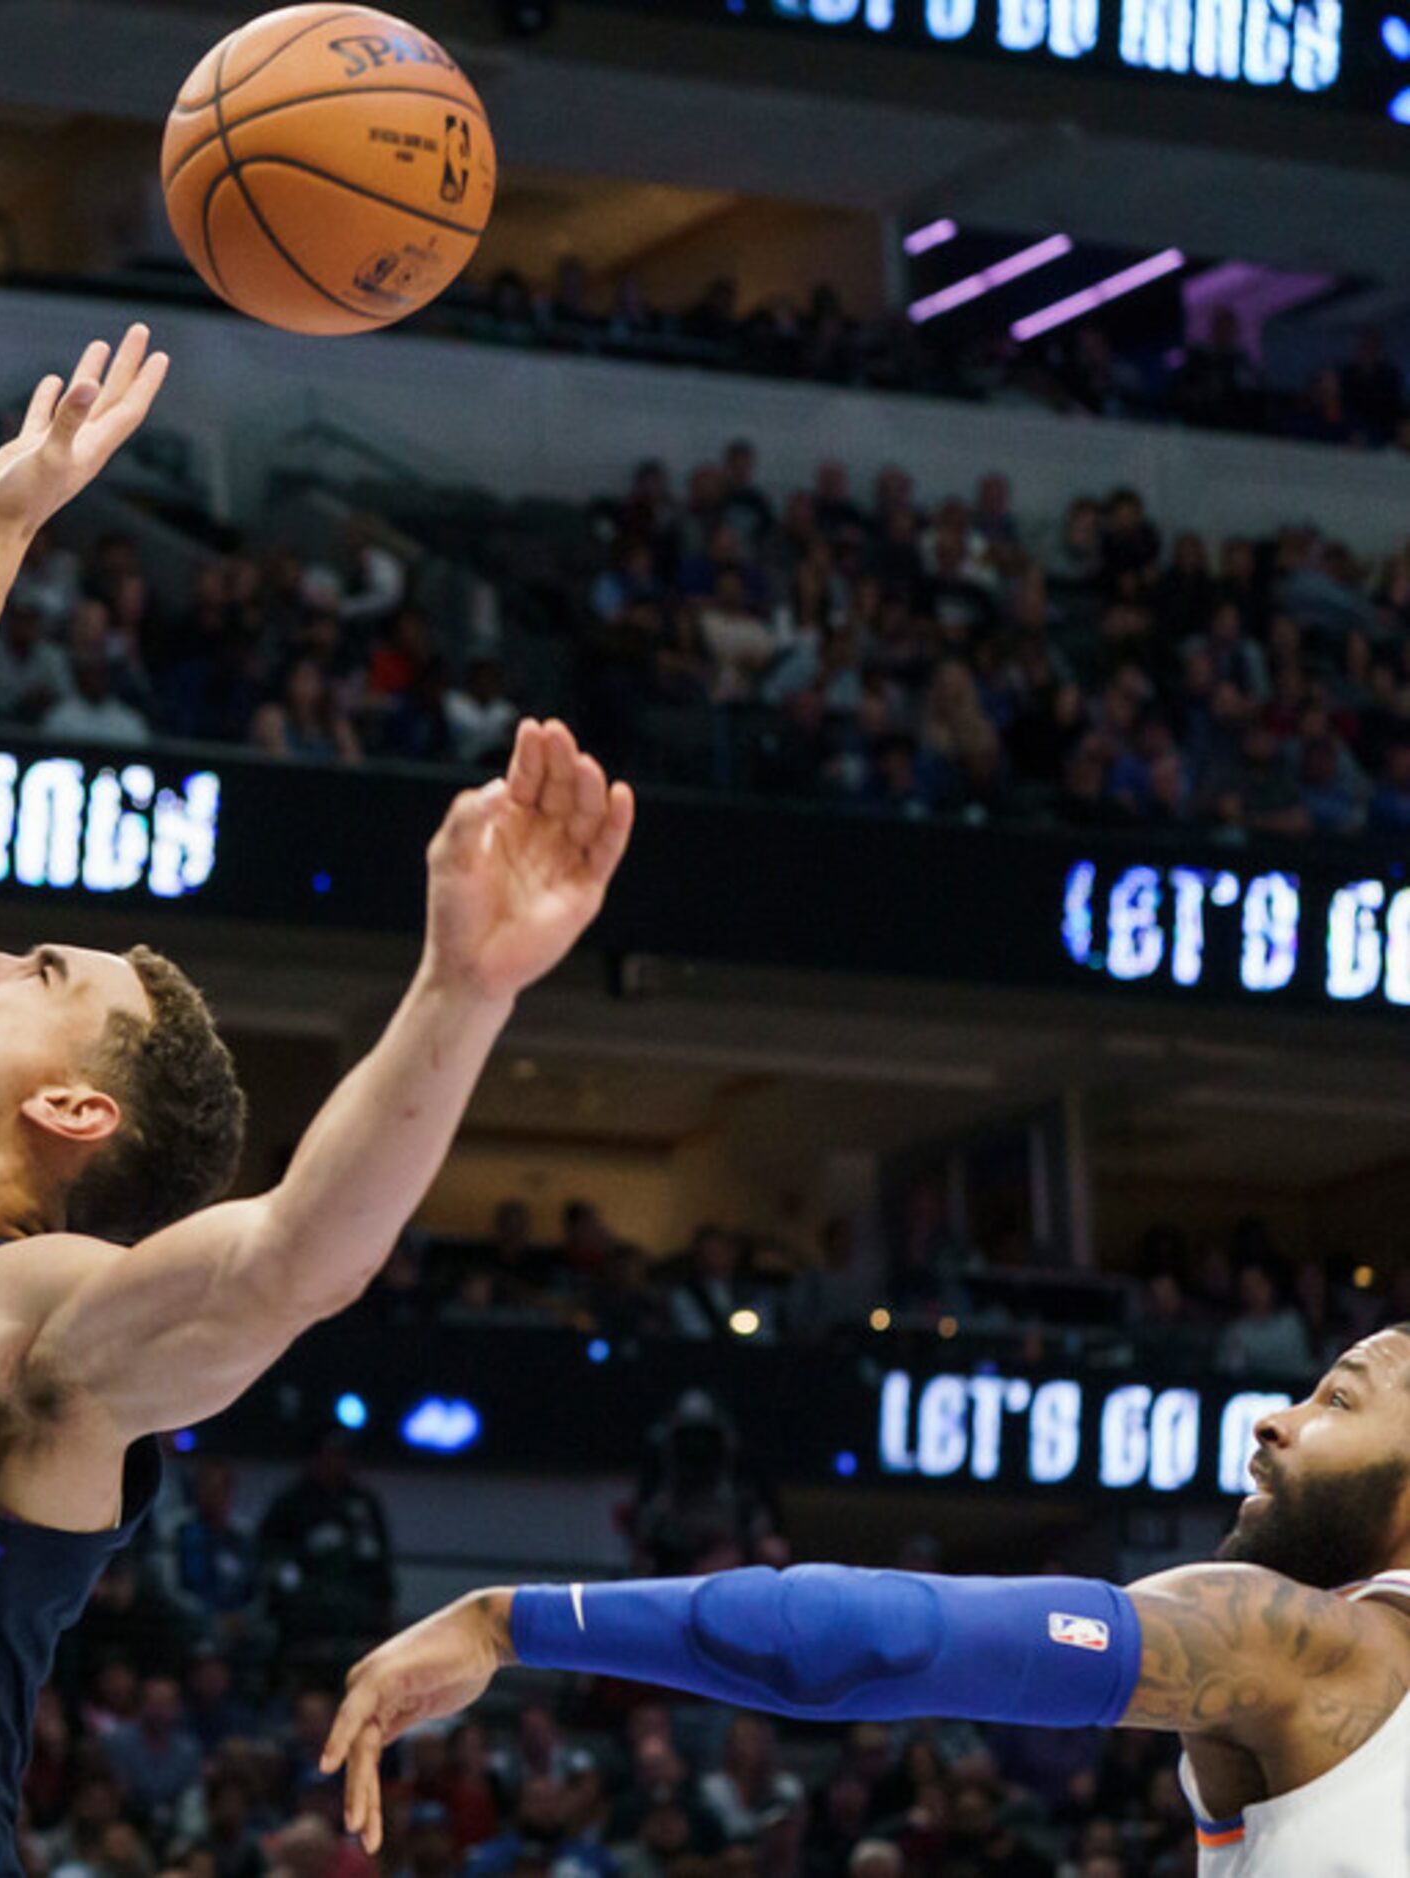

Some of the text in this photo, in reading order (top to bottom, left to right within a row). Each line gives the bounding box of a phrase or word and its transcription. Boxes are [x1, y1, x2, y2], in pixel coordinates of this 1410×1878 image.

[1062, 860, 1301, 992] LET'S
[879, 1369, 1081, 1483] LET'S
[1099, 1384, 1200, 1491] GO
